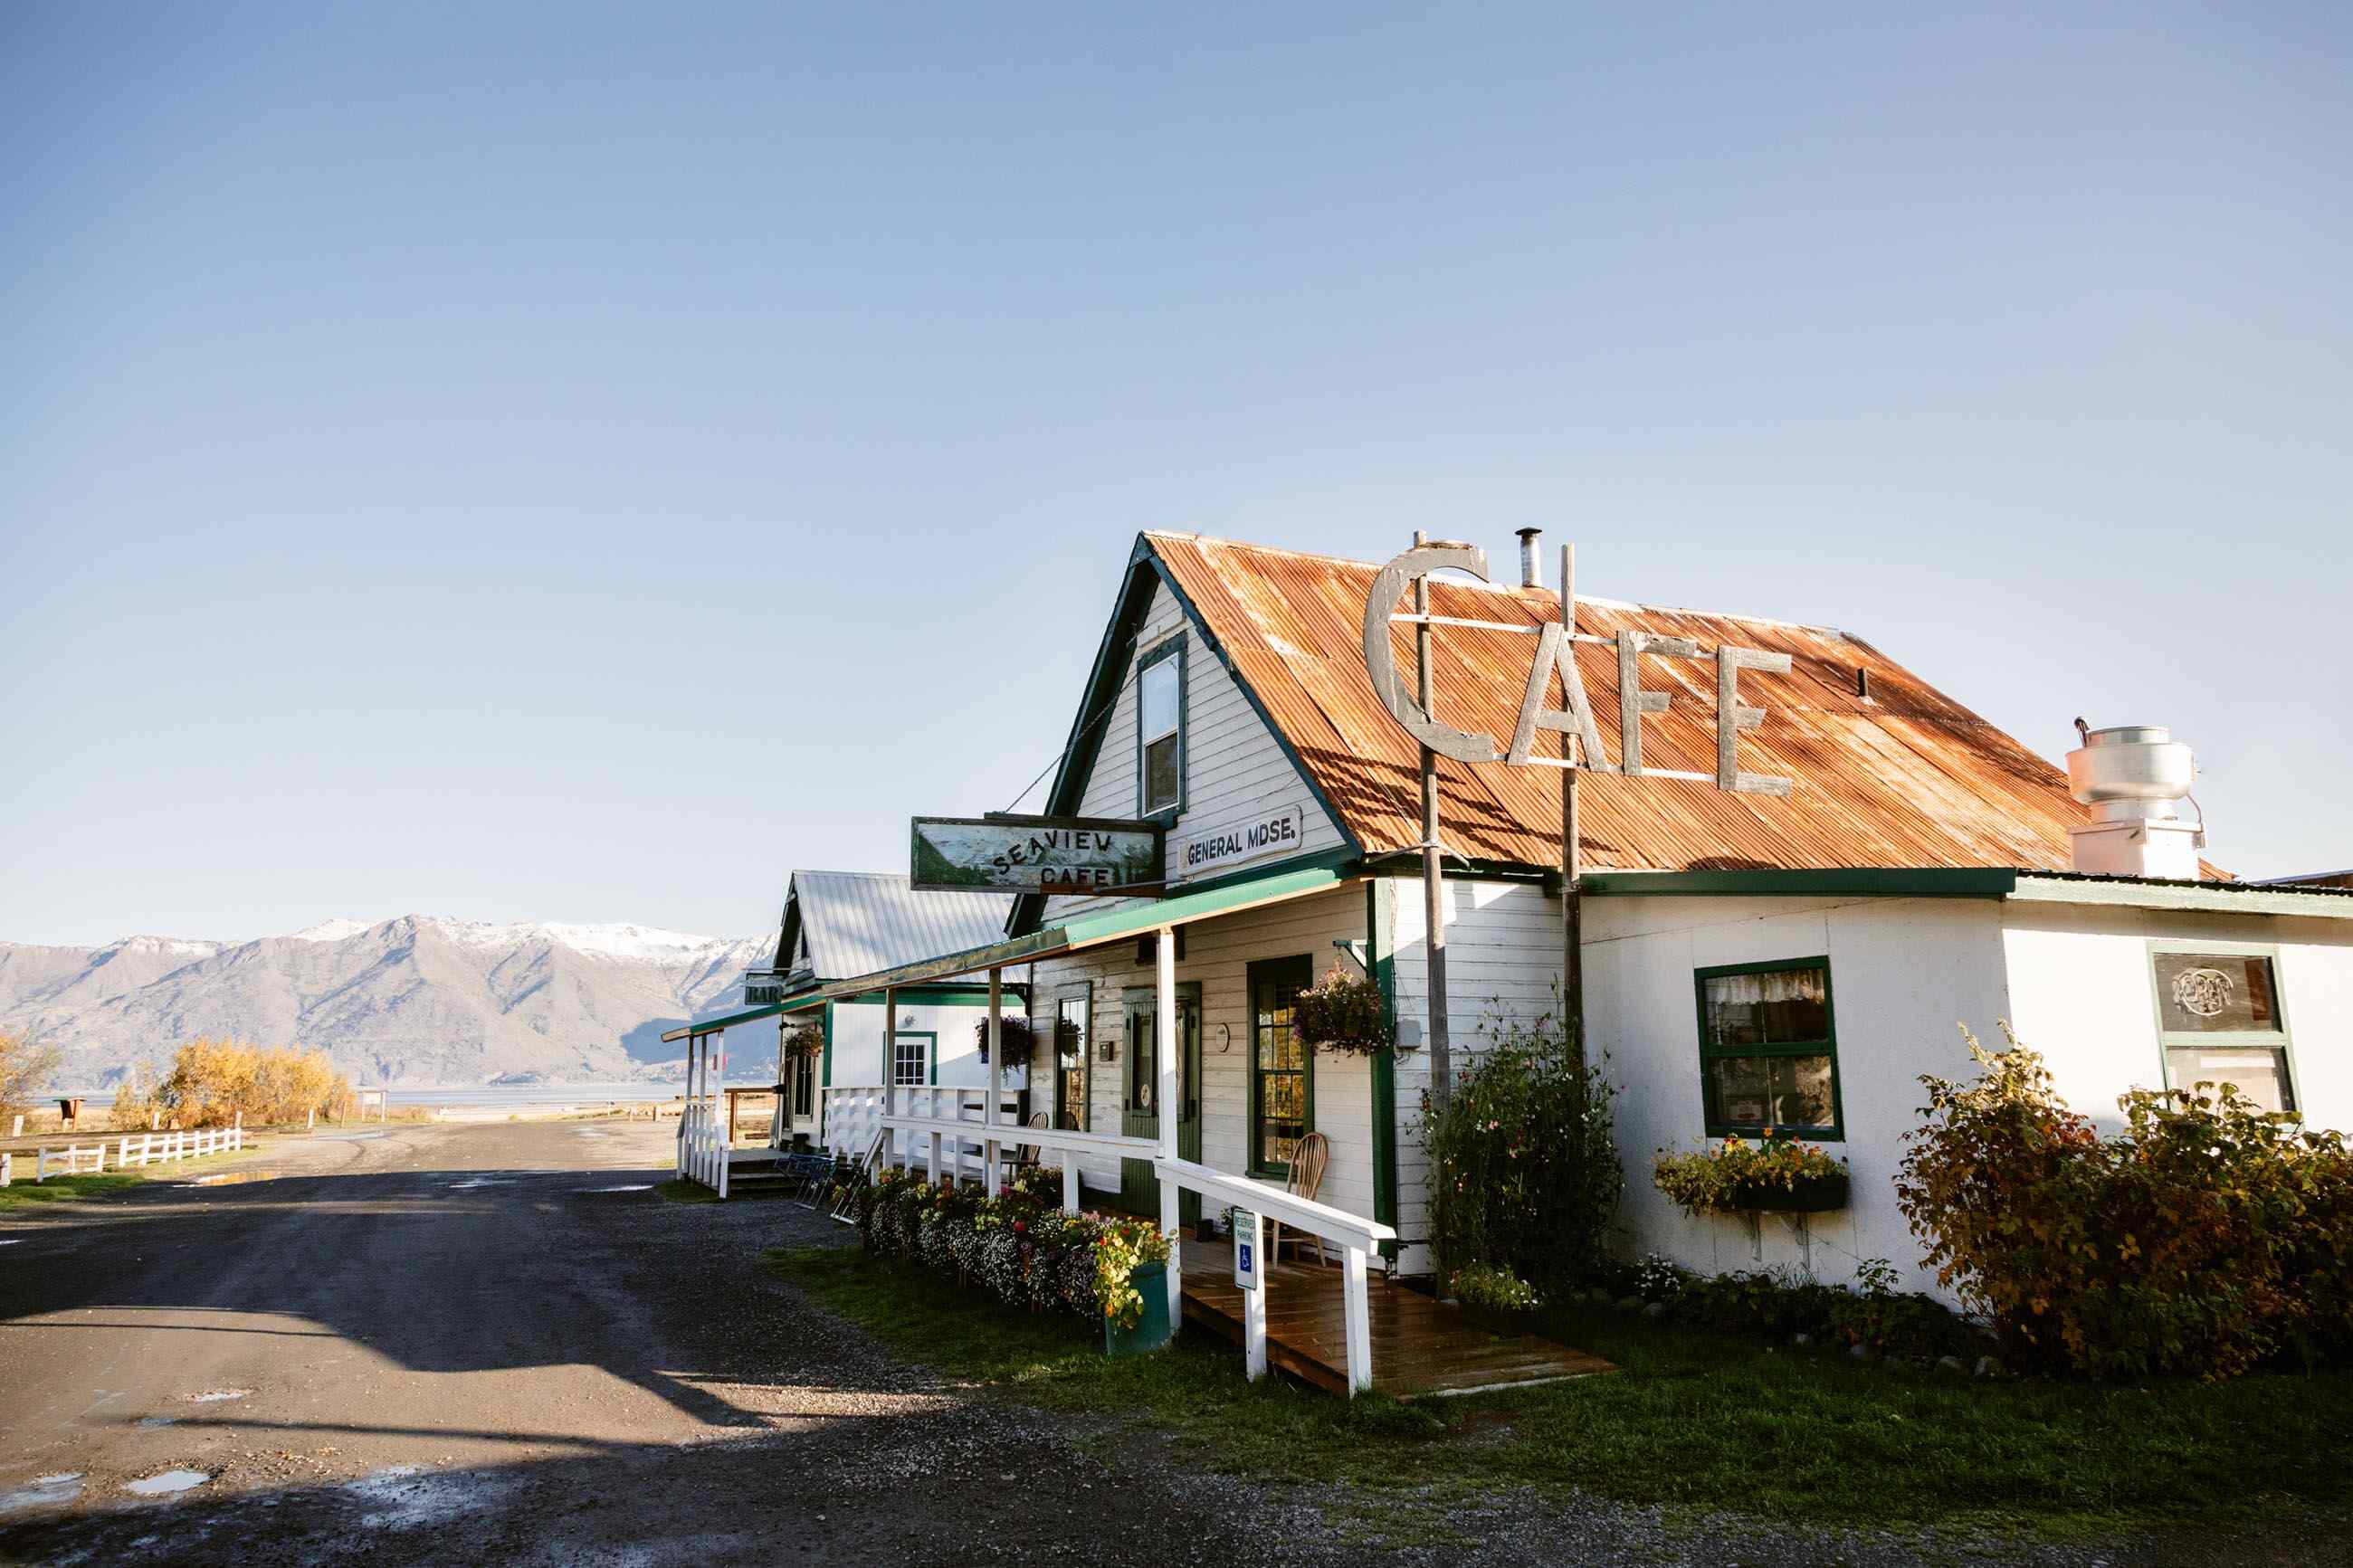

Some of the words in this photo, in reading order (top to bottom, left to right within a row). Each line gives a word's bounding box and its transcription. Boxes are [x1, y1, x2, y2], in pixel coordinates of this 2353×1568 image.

[1364, 541, 1792, 796] CAFE
[993, 830, 1111, 875] SEAVIEW
[1188, 832, 1243, 865] GENERAL
[1247, 817, 1296, 850] MDSE.
[1041, 868, 1109, 886] CAFE
